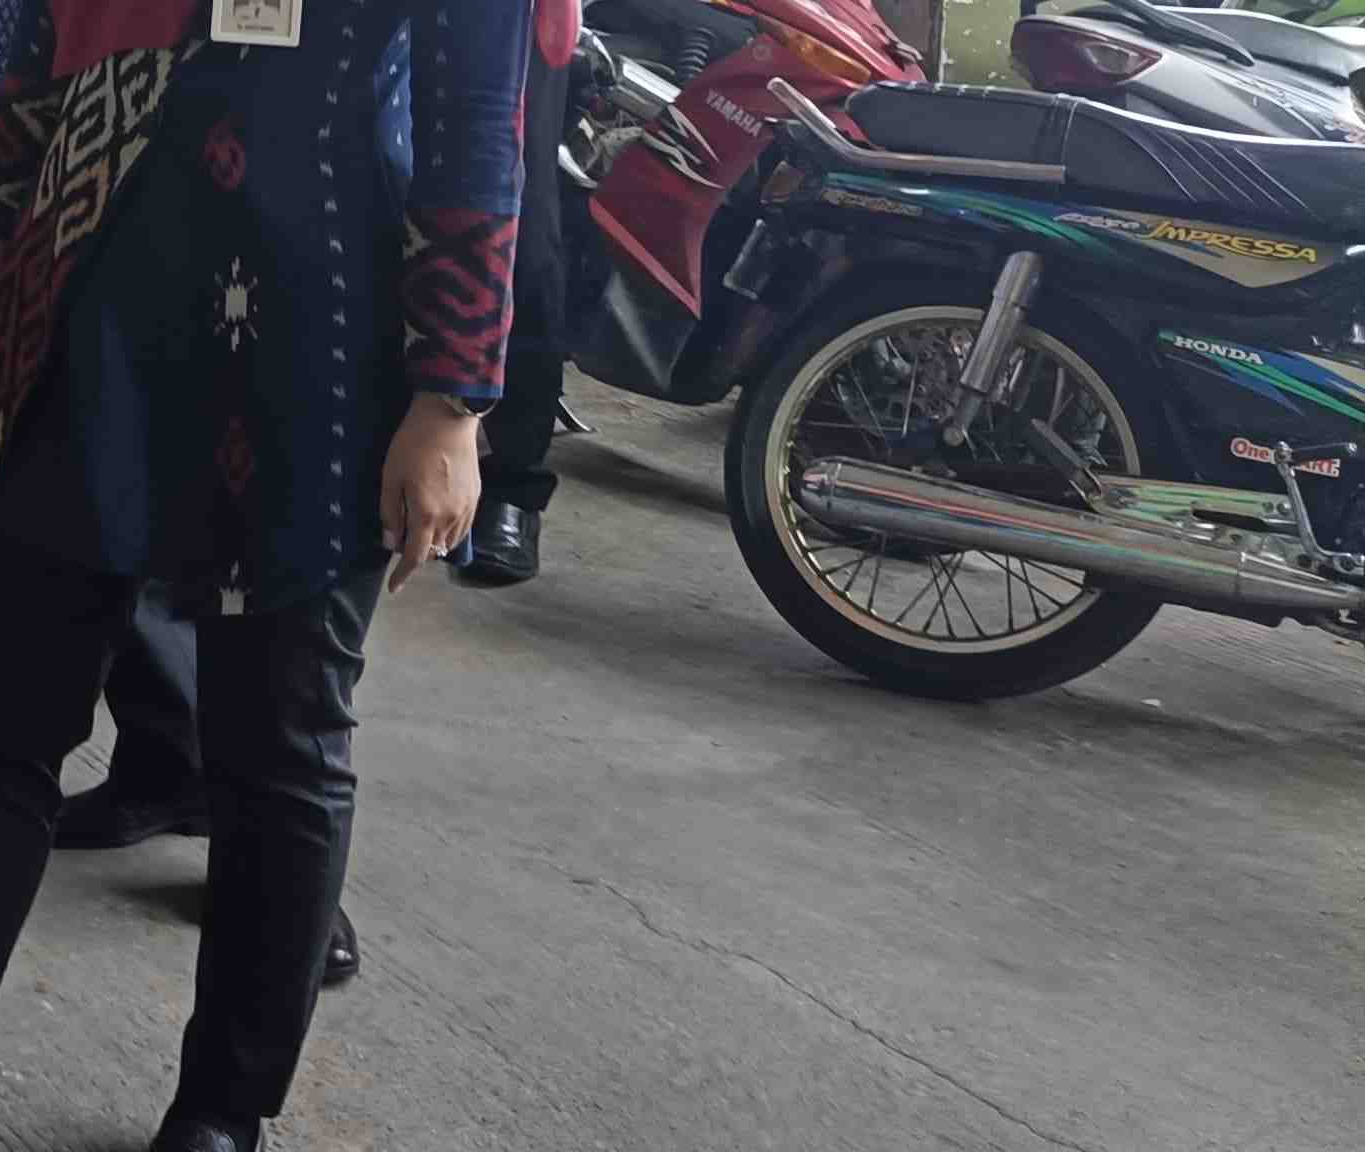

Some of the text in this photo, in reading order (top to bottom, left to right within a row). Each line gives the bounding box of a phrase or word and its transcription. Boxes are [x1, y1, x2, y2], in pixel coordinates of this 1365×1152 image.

[706, 88, 763, 137] YAMAHA
[1139, 220, 1317, 263] IMPRESSA
[1173, 335, 1264, 365] HONDA
[1235, 439, 1270, 460] One
